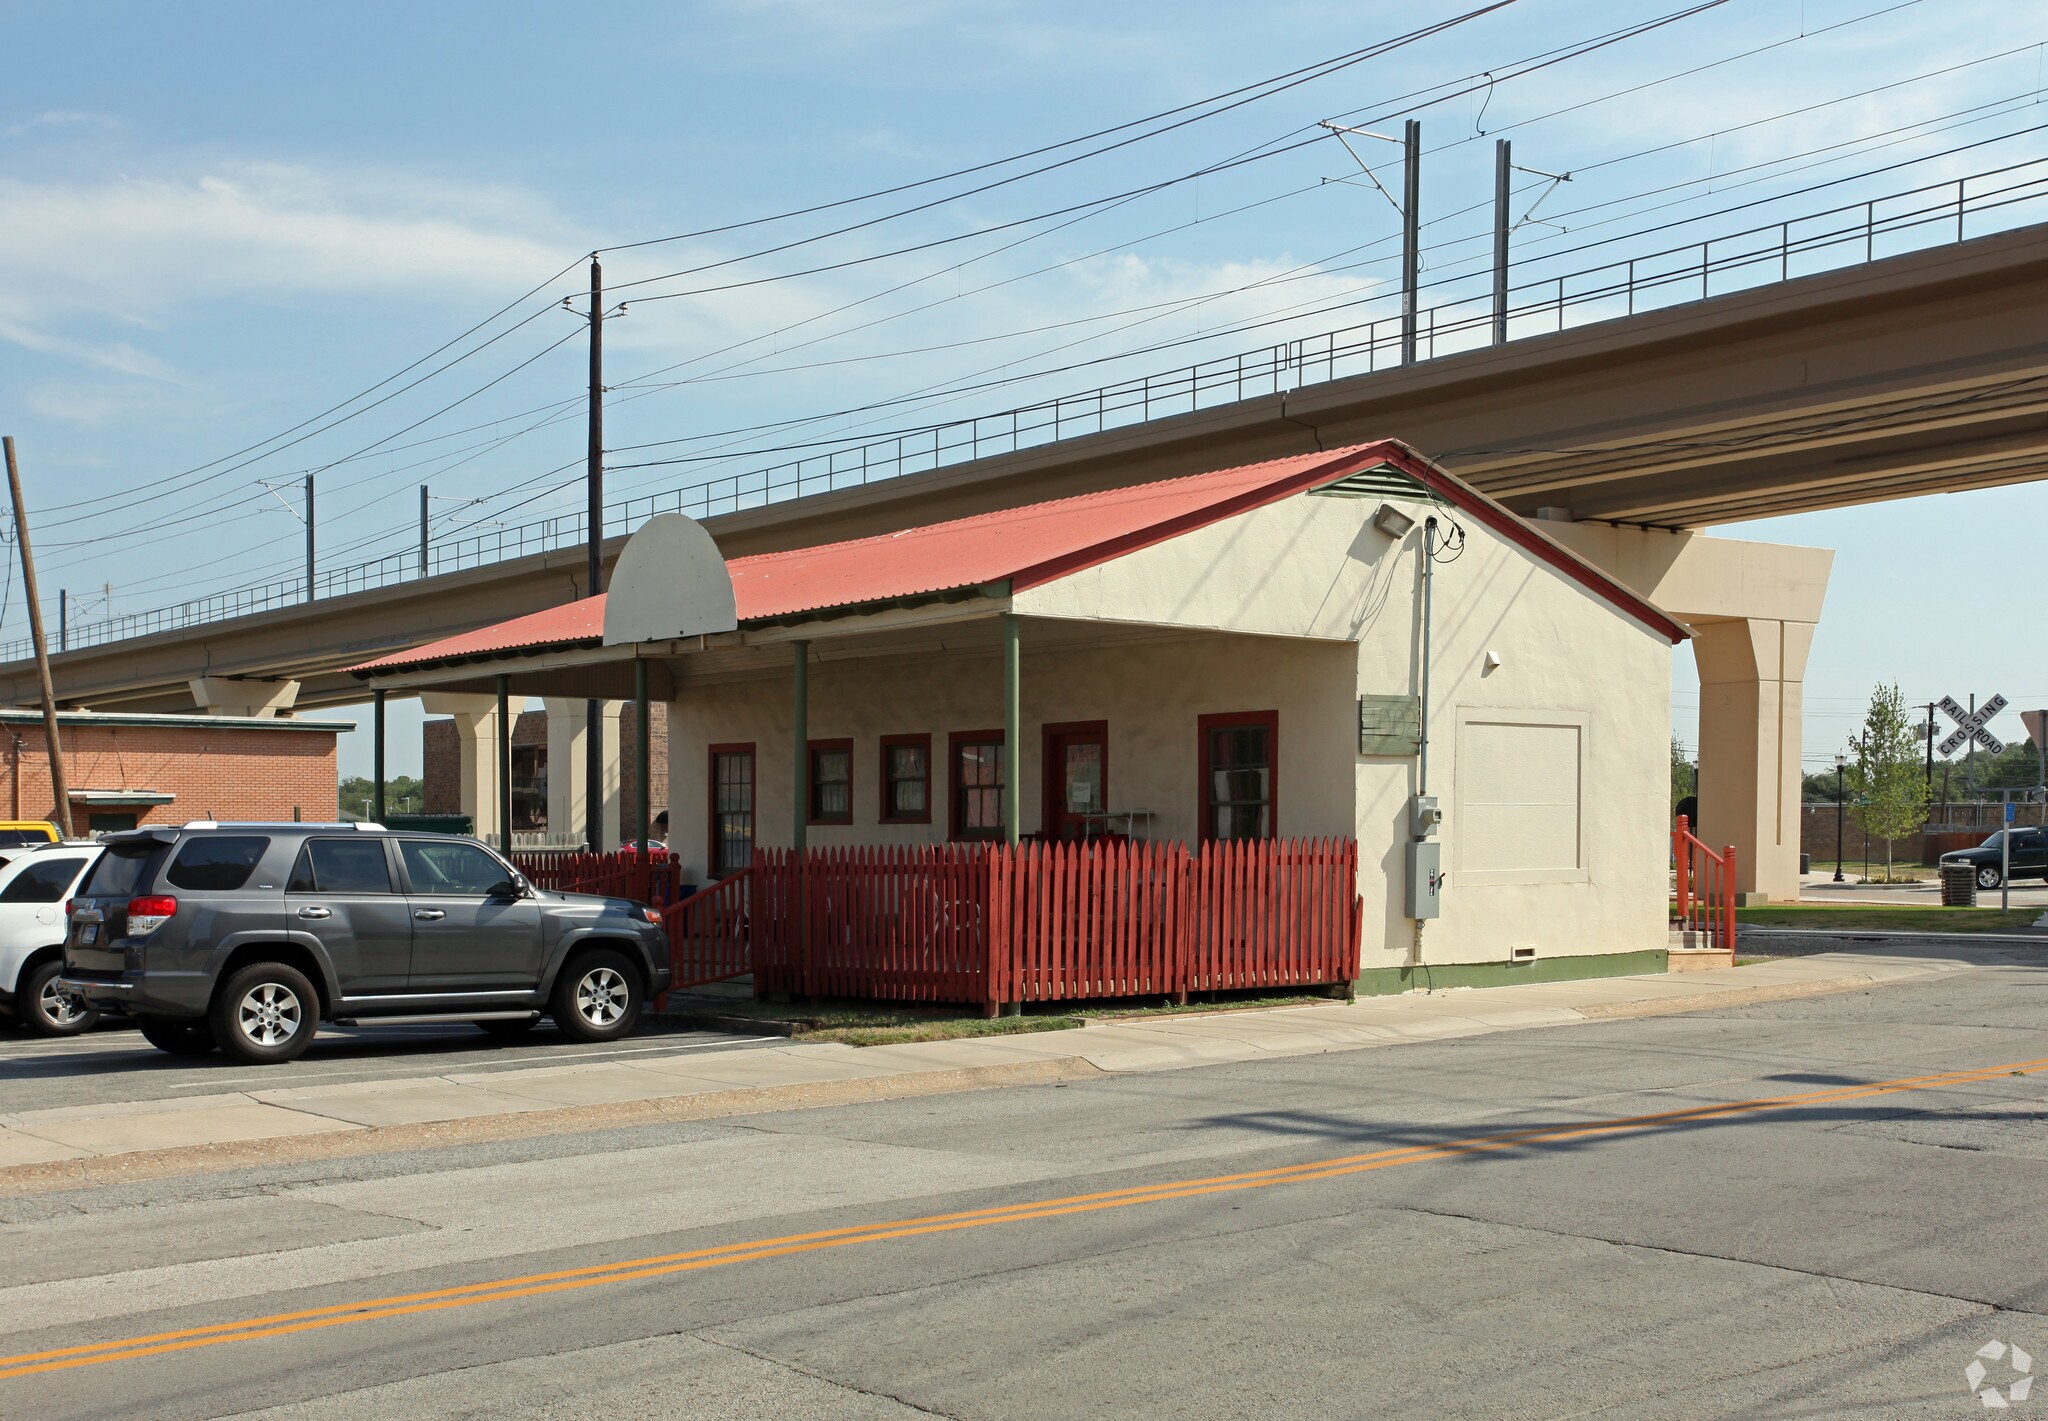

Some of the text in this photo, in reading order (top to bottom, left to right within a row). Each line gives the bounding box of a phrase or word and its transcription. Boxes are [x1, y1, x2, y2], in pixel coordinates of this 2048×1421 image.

[1940, 696, 2004, 755] CROSSING
[1940, 698, 2002, 755] RAIL ROAD
